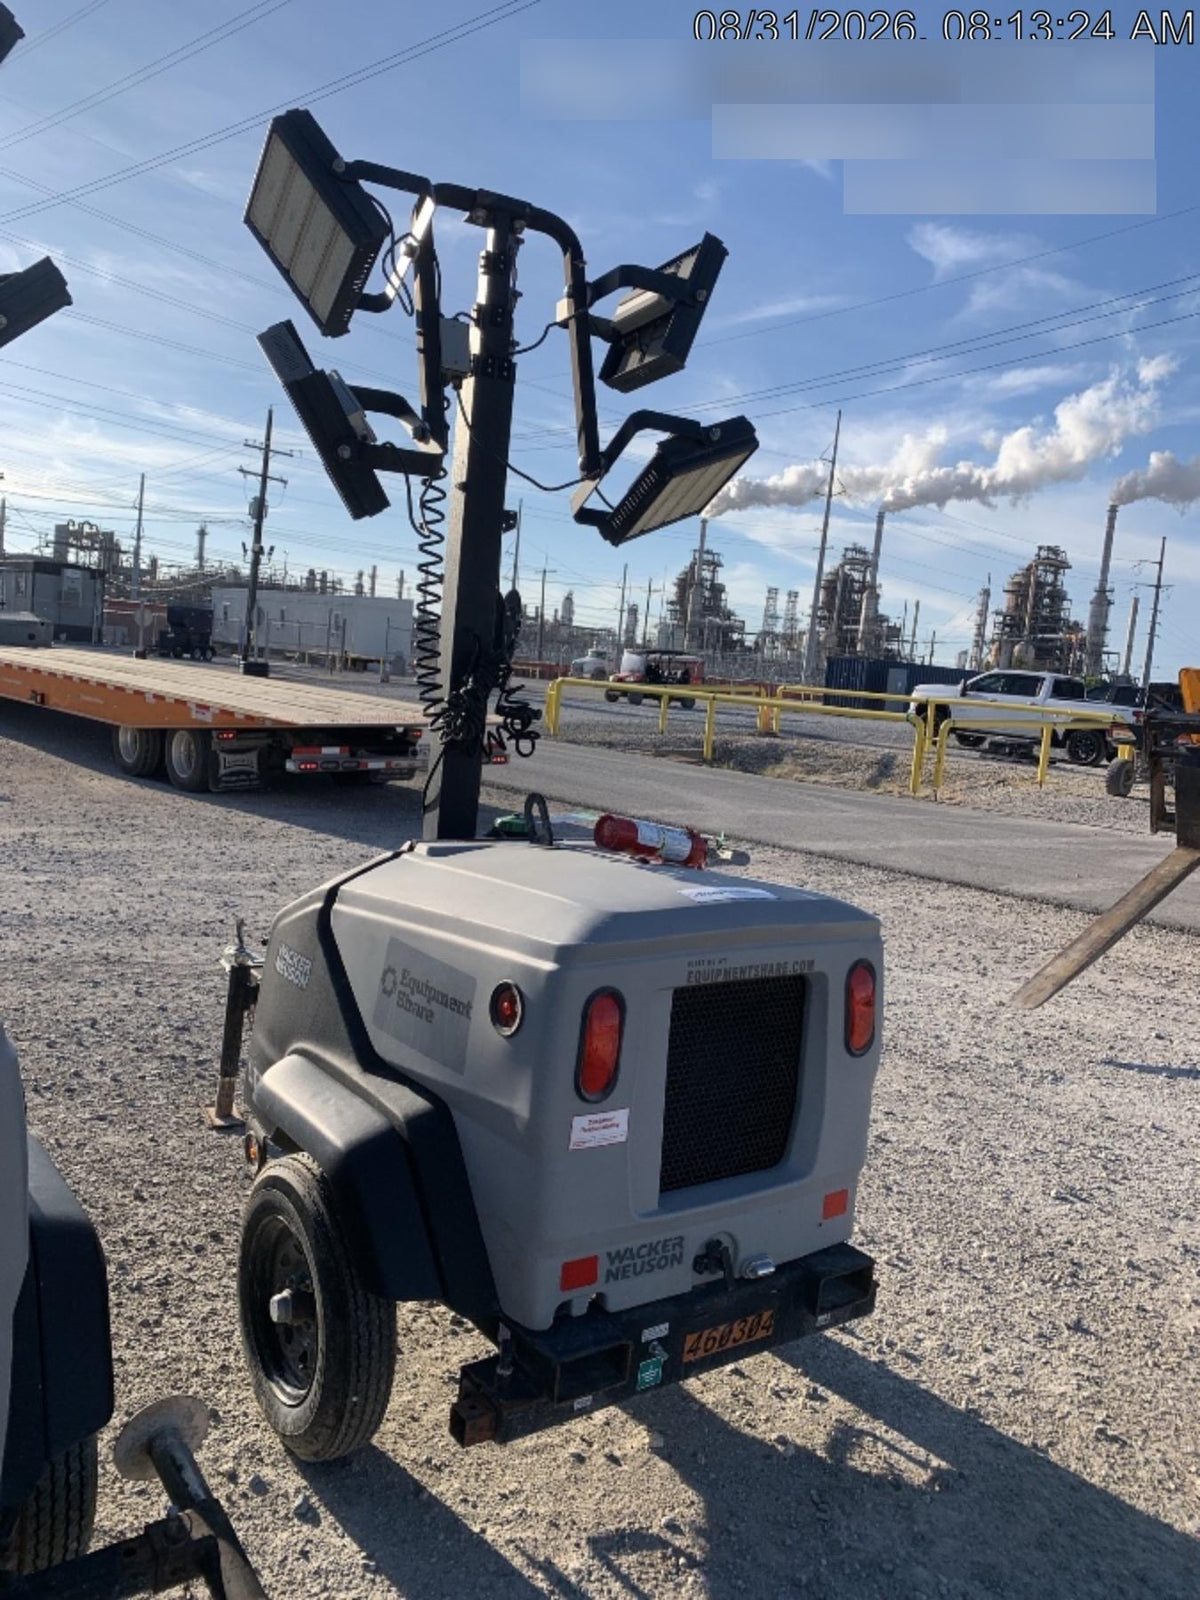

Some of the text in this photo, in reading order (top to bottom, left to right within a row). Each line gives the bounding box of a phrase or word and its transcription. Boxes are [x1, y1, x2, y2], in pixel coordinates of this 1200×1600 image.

[396, 990, 435, 1023] Share
[399, 968, 473, 1019] Equipment
[604, 1251, 684, 1284] NEUSON
[605, 1236, 685, 1267] WACKER
[686, 1311, 775, 1357] 460304
